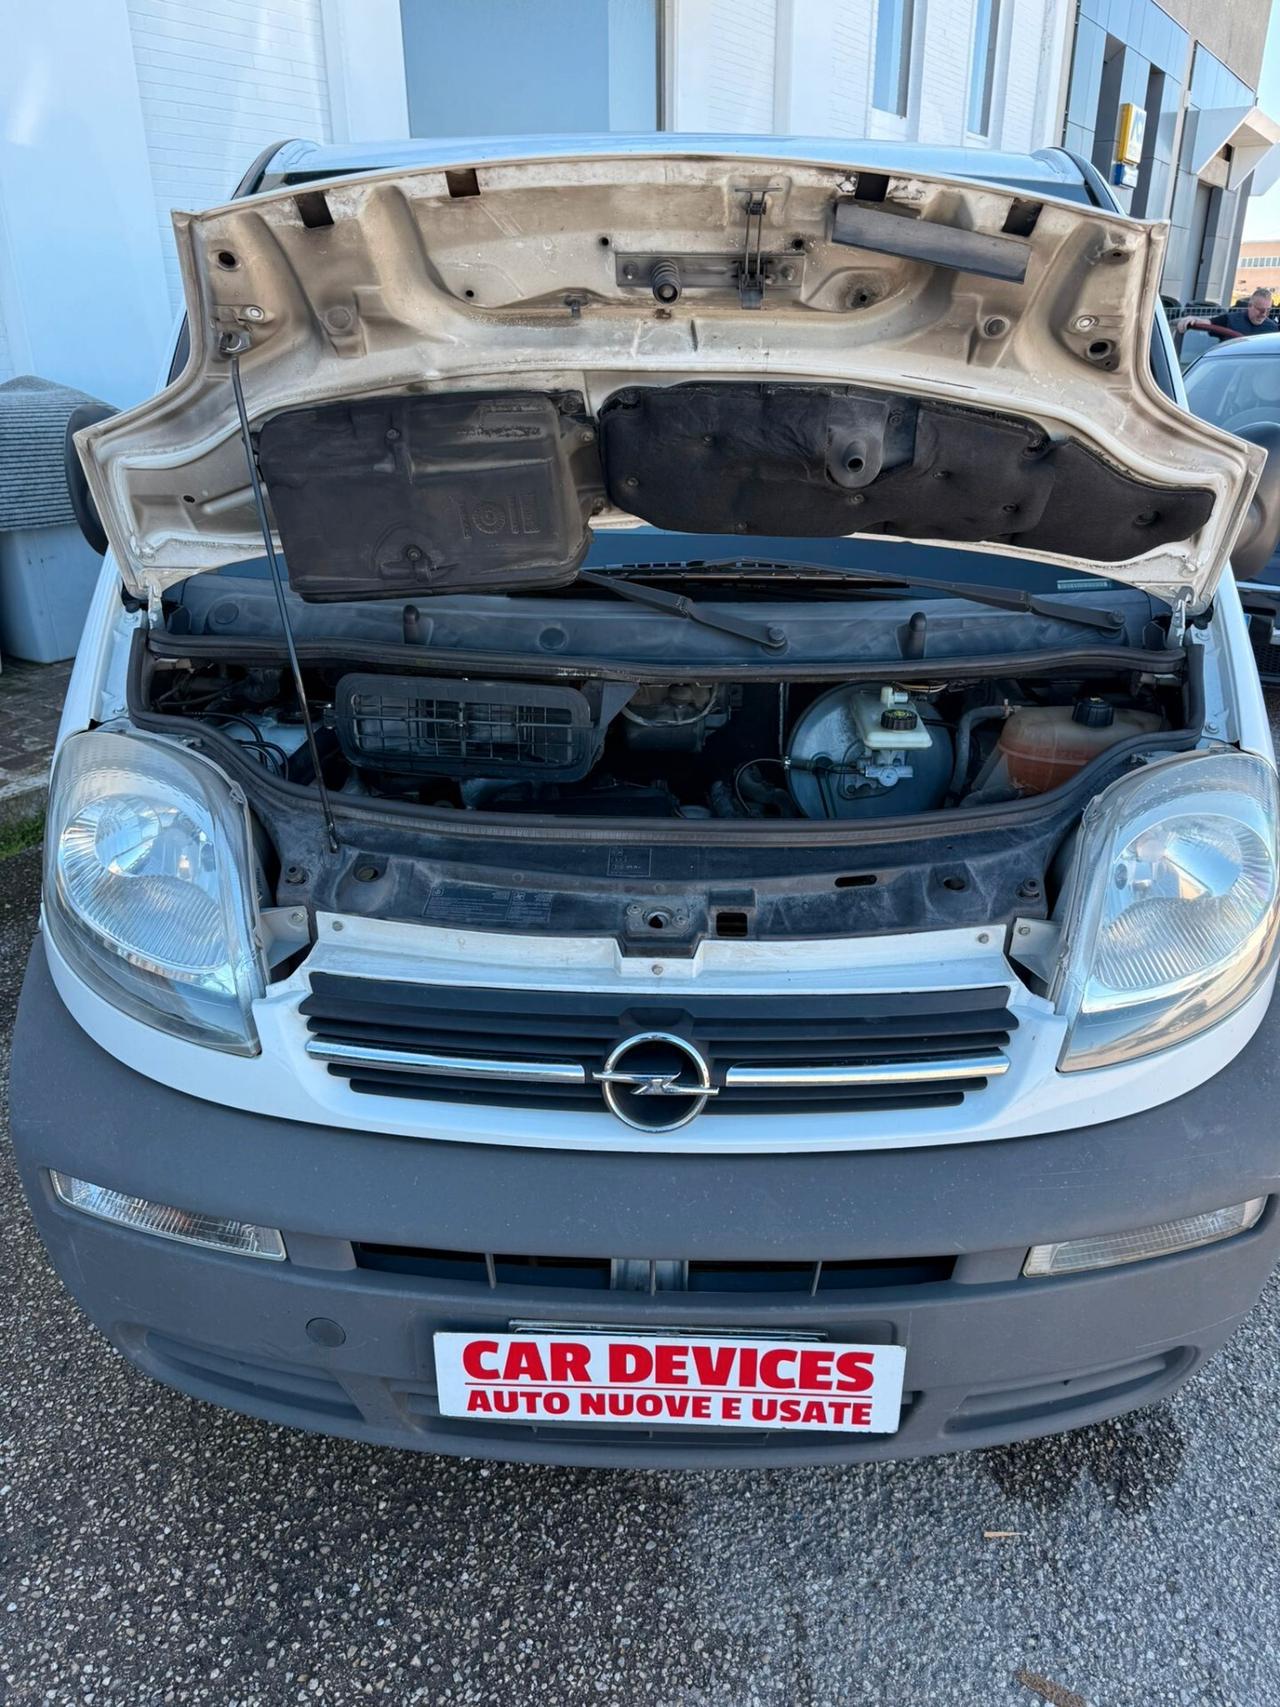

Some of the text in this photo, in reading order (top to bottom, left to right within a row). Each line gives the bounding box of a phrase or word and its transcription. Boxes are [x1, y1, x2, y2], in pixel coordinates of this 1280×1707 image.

[462, 1340, 874, 1393] CAR DEVICES
[466, 1389, 872, 1426] AUTO NUOVE E USATE
